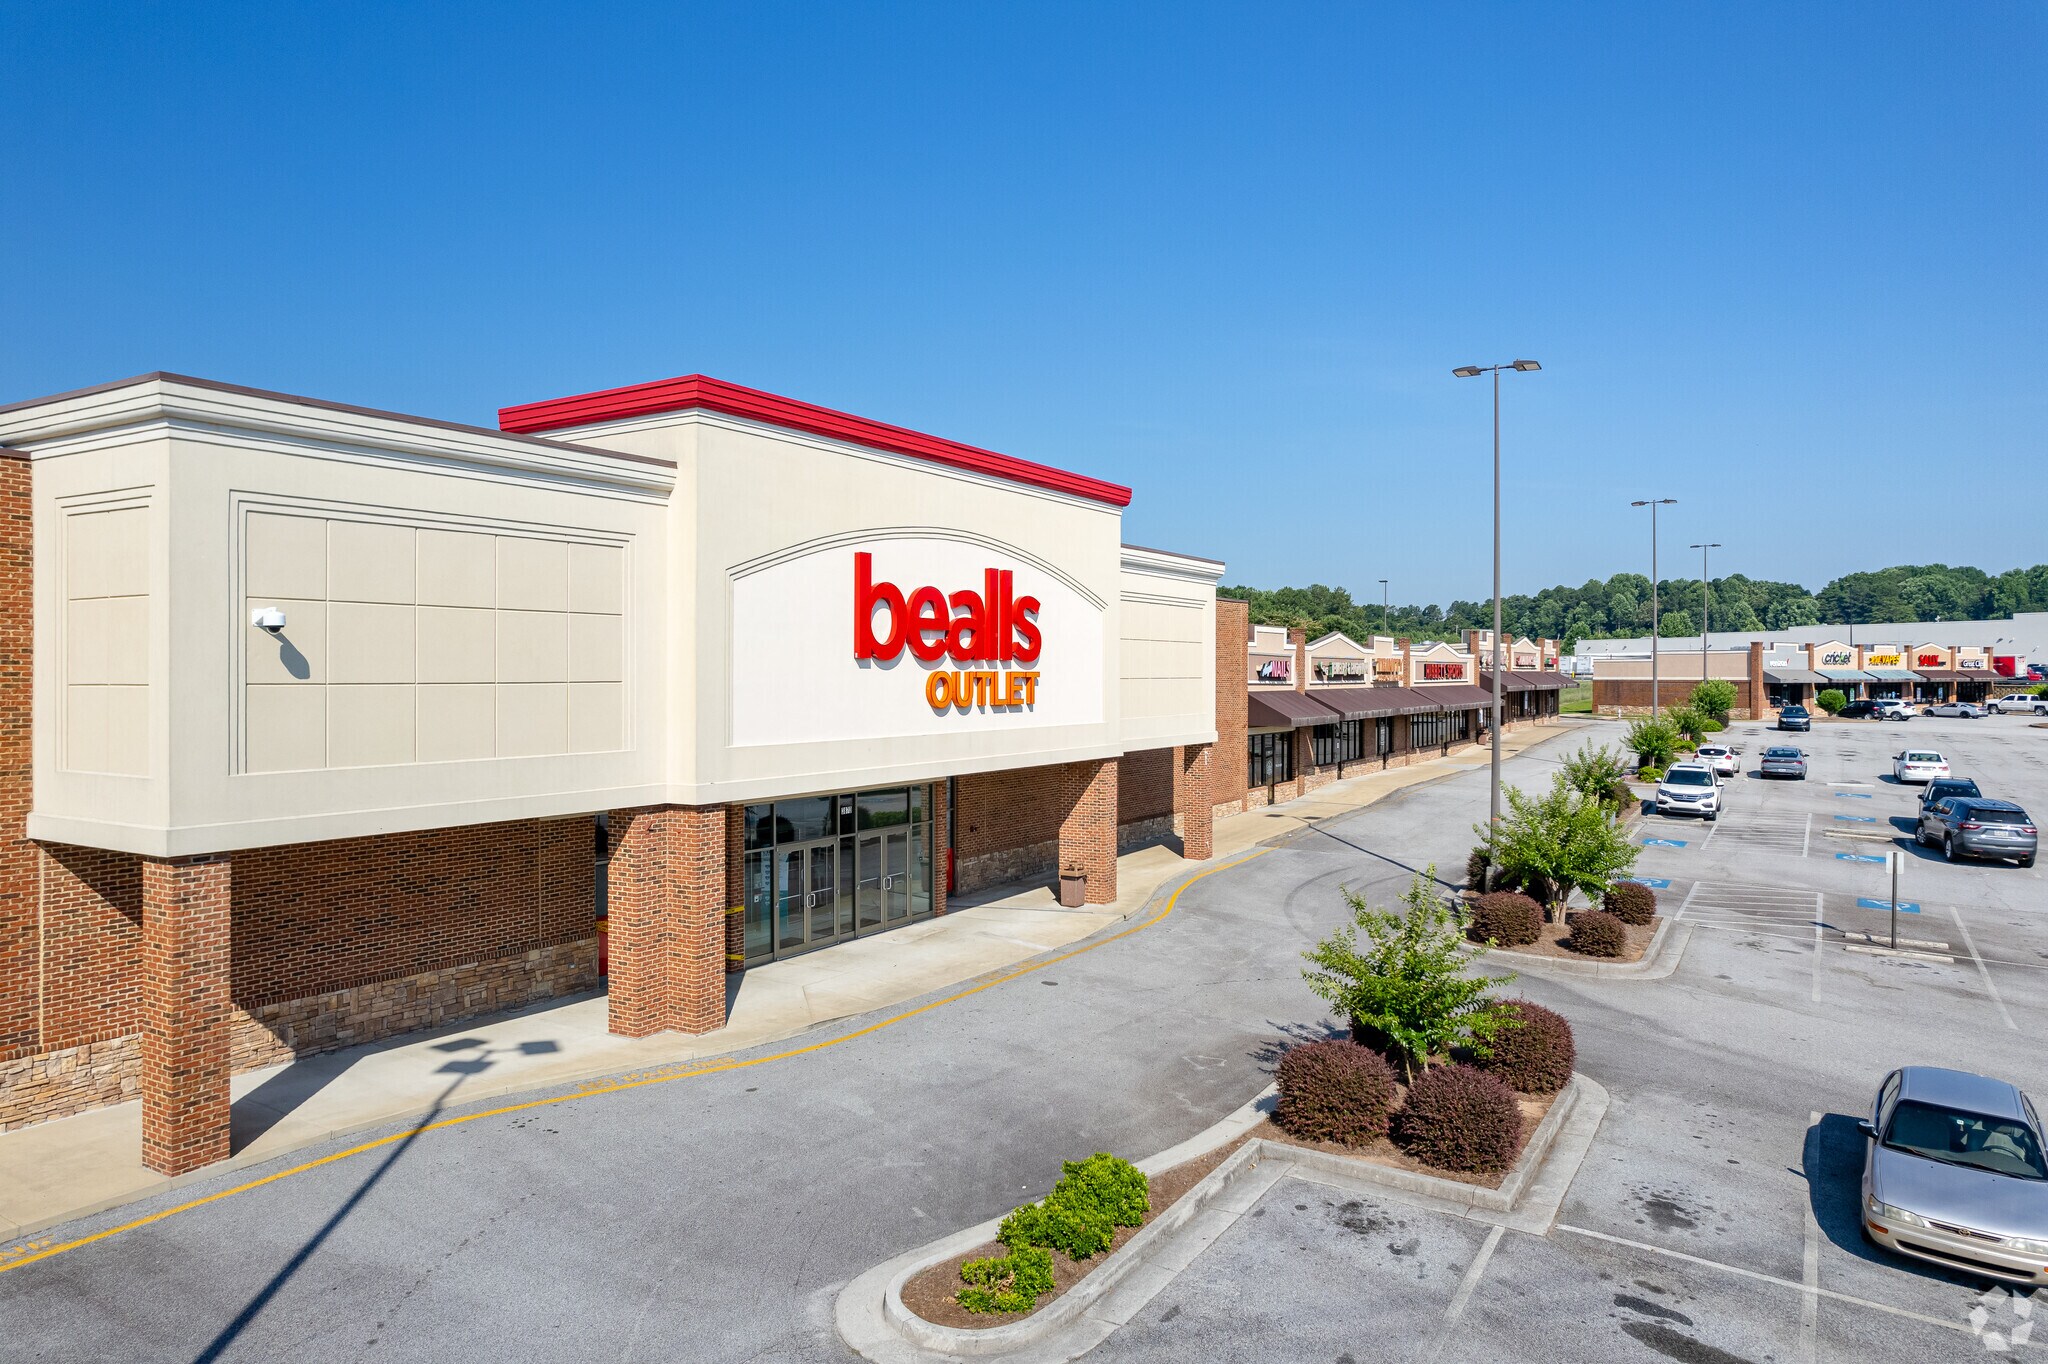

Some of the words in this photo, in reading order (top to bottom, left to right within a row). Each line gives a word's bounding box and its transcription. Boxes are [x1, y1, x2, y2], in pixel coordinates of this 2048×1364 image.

[854, 551, 1042, 662] bealls
[1271, 660, 1290, 677] NAILS
[1823, 651, 1852, 663] cricket
[926, 670, 1040, 709] OUTLET
[578, 1078, 618, 1091] NO
[622, 1057, 737, 1082] PARKING
